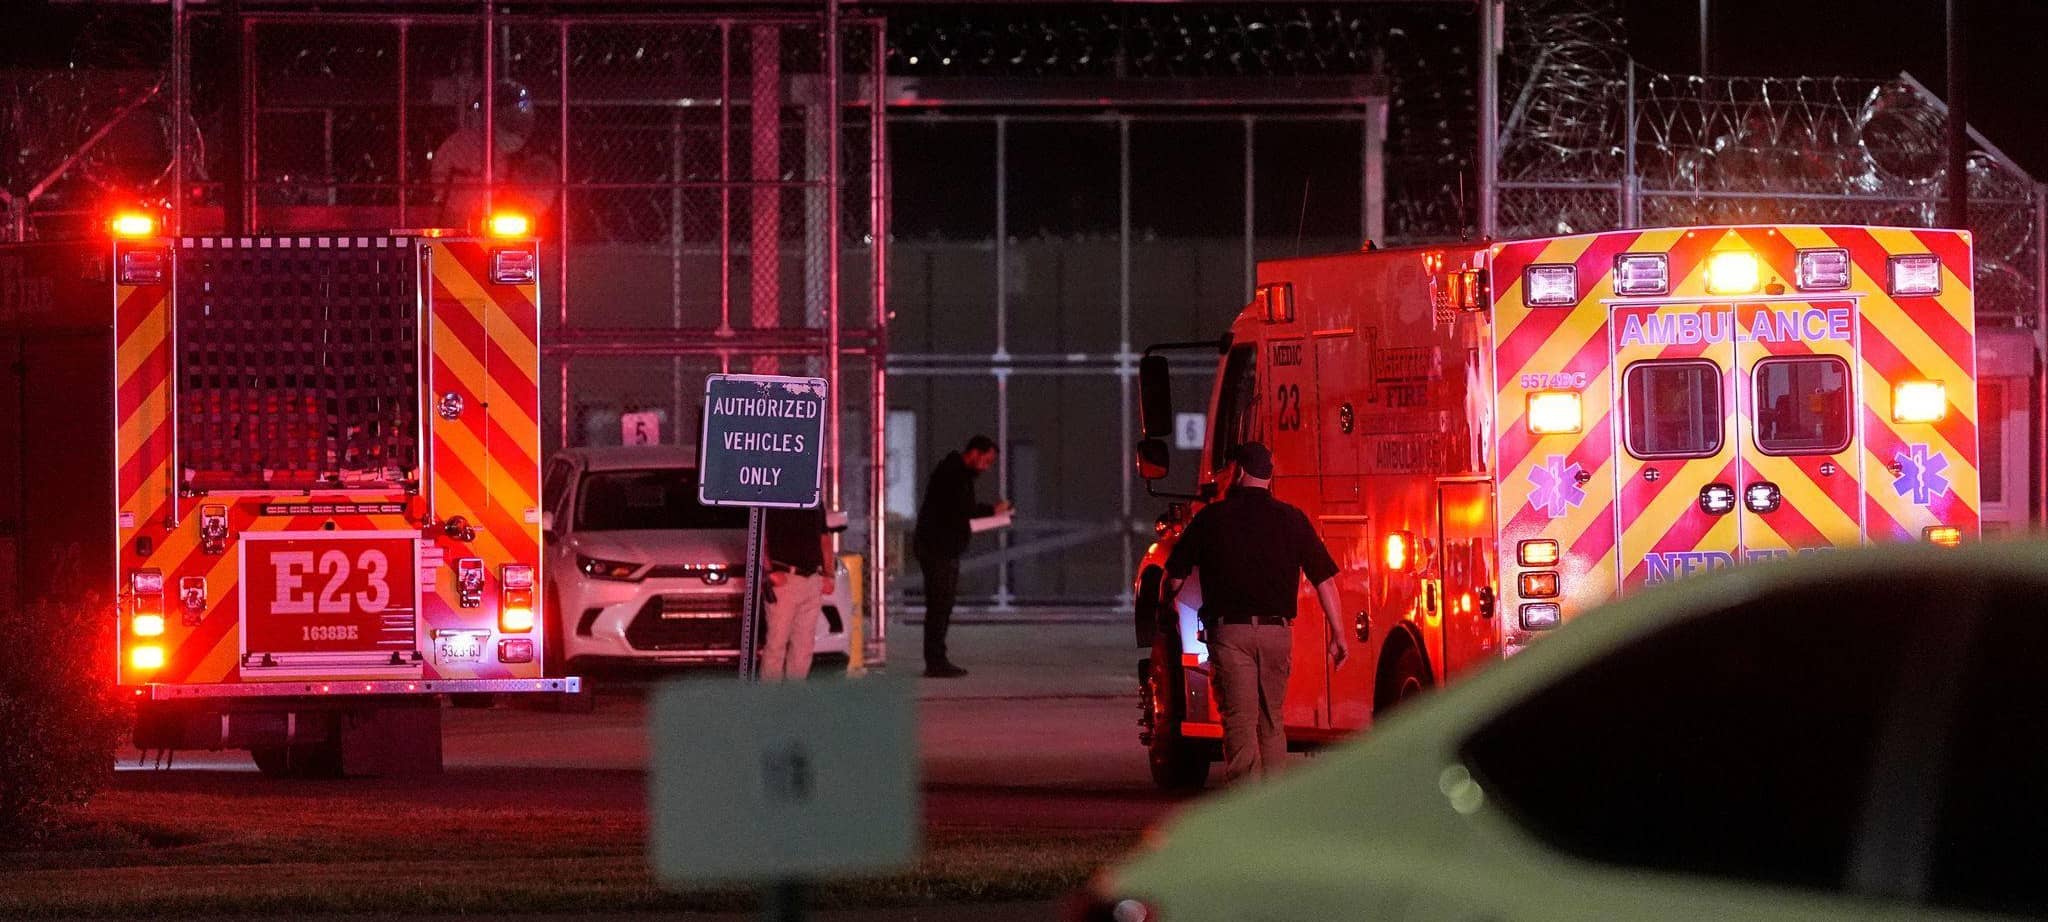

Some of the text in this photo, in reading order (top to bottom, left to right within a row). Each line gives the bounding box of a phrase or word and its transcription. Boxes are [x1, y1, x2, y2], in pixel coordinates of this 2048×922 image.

[1621, 308, 1850, 346] AMBULANCE
[1273, 344, 1302, 367] MEDIC
[1521, 371, 1586, 389] 5574BC
[1386, 384, 1428, 408] FIRE
[713, 397, 817, 419] AUTHORIZED
[1277, 383, 1300, 432] 23
[636, 421, 647, 445] 5
[1186, 420, 1197, 442] 6
[724, 432, 804, 453] VEHICLES
[739, 466, 781, 486] ONLY
[270, 549, 390, 614] E23
[302, 625, 358, 640] 1638BE
